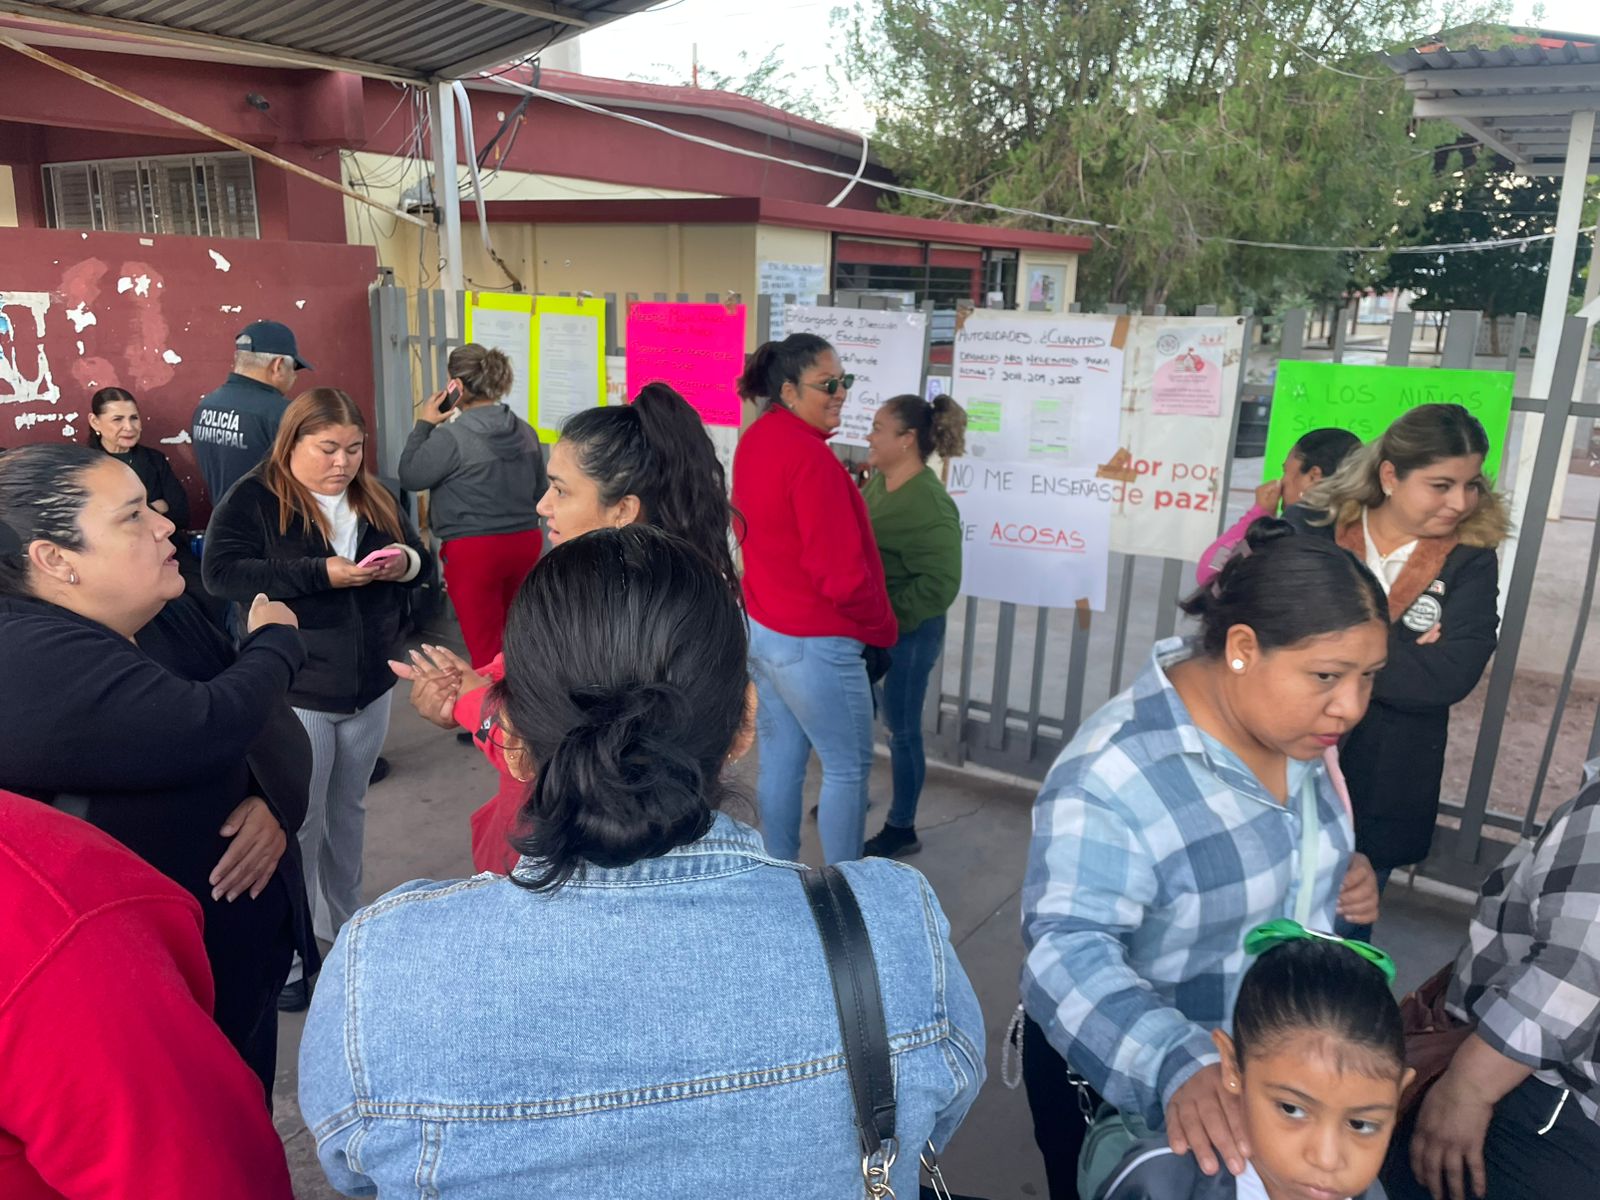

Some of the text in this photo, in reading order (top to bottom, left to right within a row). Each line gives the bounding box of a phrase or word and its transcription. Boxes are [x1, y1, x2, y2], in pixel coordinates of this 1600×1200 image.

[1294, 382, 1483, 410] A LOS NIÑOS
[199, 409, 239, 431] POLICÍA
[193, 425, 248, 449] MUNICIPAL
[951, 464, 1113, 502] NO ME ENSEÑAS
[1171, 462, 1218, 483] por
[1154, 487, 1217, 514] paz!
[990, 522, 1086, 549] ACOSAS
